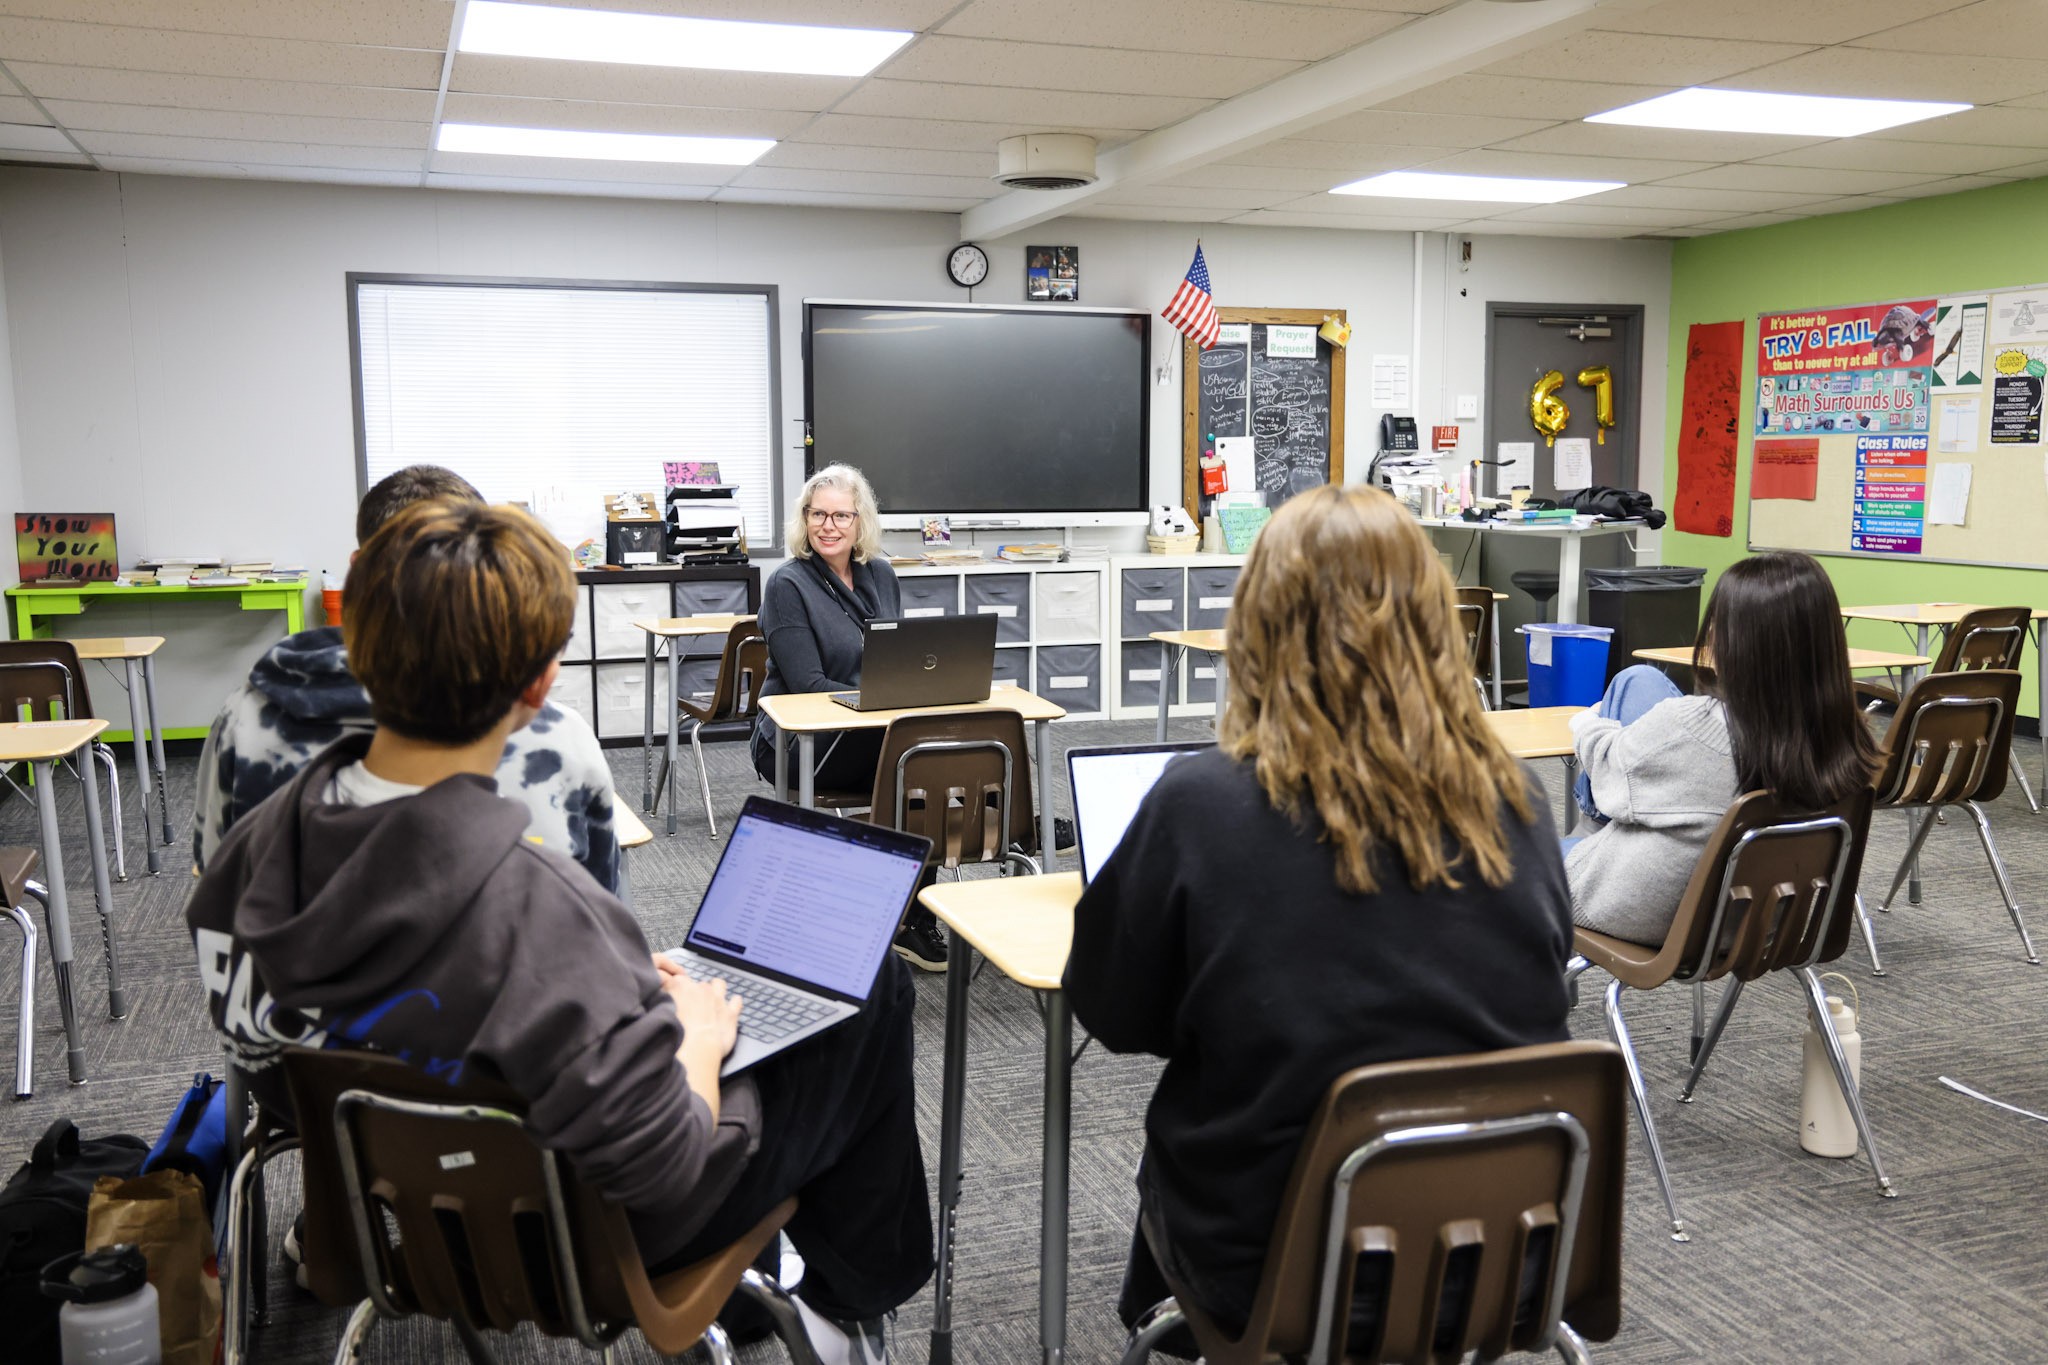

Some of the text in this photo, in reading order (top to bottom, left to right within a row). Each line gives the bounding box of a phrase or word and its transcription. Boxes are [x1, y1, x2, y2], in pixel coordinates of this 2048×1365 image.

[1771, 315, 1827, 330] It's better to
[1220, 328, 1241, 338] aise
[1275, 329, 1310, 340] Prayer
[1764, 320, 1877, 359] TRY & FAIL
[1270, 343, 1314, 355] Requests
[1773, 352, 1878, 371] than to never try at all!
[1774, 388, 1915, 414] Math Surrounds Us
[1915, 415, 1926, 424] 30
[1440, 427, 1457, 439] FIRE
[1857, 436, 1927, 450] Class Rules
[1856, 470, 1866, 480] 2.
[1855, 486, 1866, 497] 3.
[1854, 504, 1865, 514] 4.
[24, 514, 91, 533] Show
[1853, 520, 1864, 531] 5.
[37, 537, 99, 556] Your
[1852, 537, 1864, 548] 6.
[48, 558, 112, 577] Work
